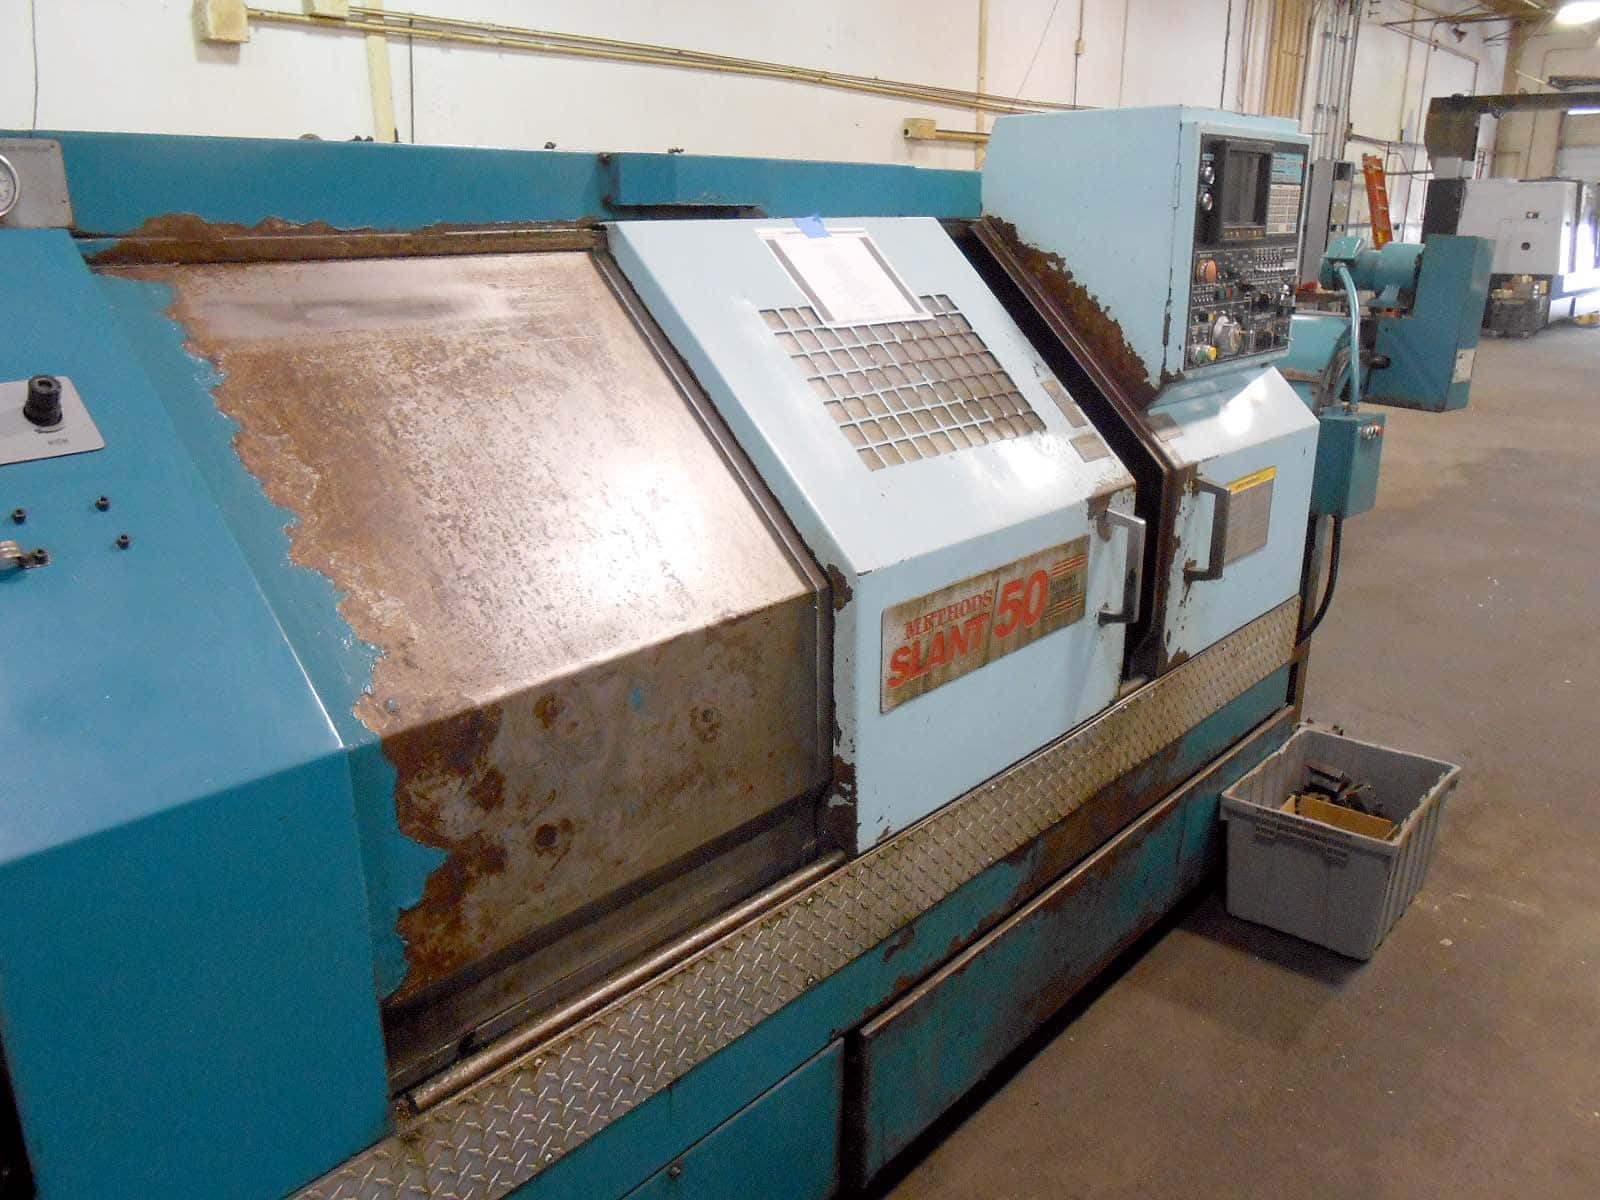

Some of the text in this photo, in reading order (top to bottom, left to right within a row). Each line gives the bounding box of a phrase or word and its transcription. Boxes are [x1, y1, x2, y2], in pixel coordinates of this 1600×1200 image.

[887, 569, 1048, 689] SLANT 50
[904, 590, 993, 640] METHODS
